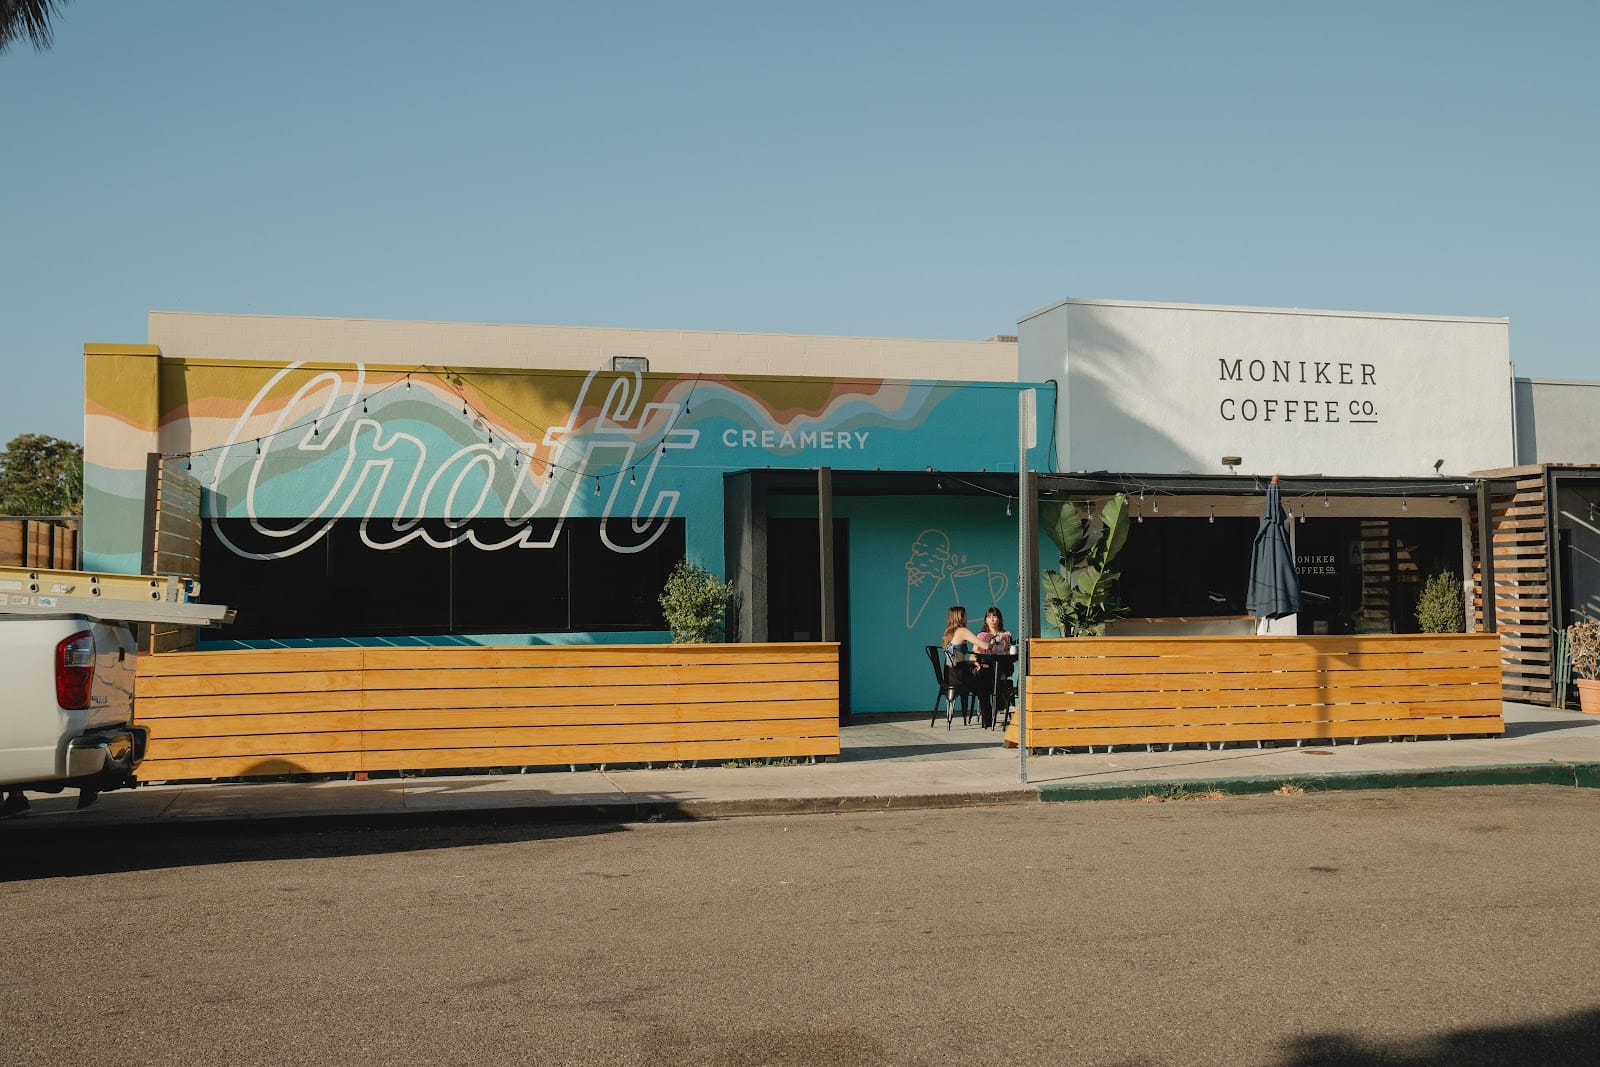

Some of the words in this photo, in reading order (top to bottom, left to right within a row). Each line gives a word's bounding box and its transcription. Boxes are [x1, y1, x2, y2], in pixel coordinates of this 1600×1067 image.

[1218, 358, 1377, 386] MONIKER
[1220, 398, 1340, 423] COFFEE
[1349, 400, 1378, 417] CO.
[722, 428, 870, 449] CREAMERY
[209, 360, 700, 560] Craft
[1295, 566, 1325, 574] OFFEE
[1297, 555, 1335, 563] ONIKER
